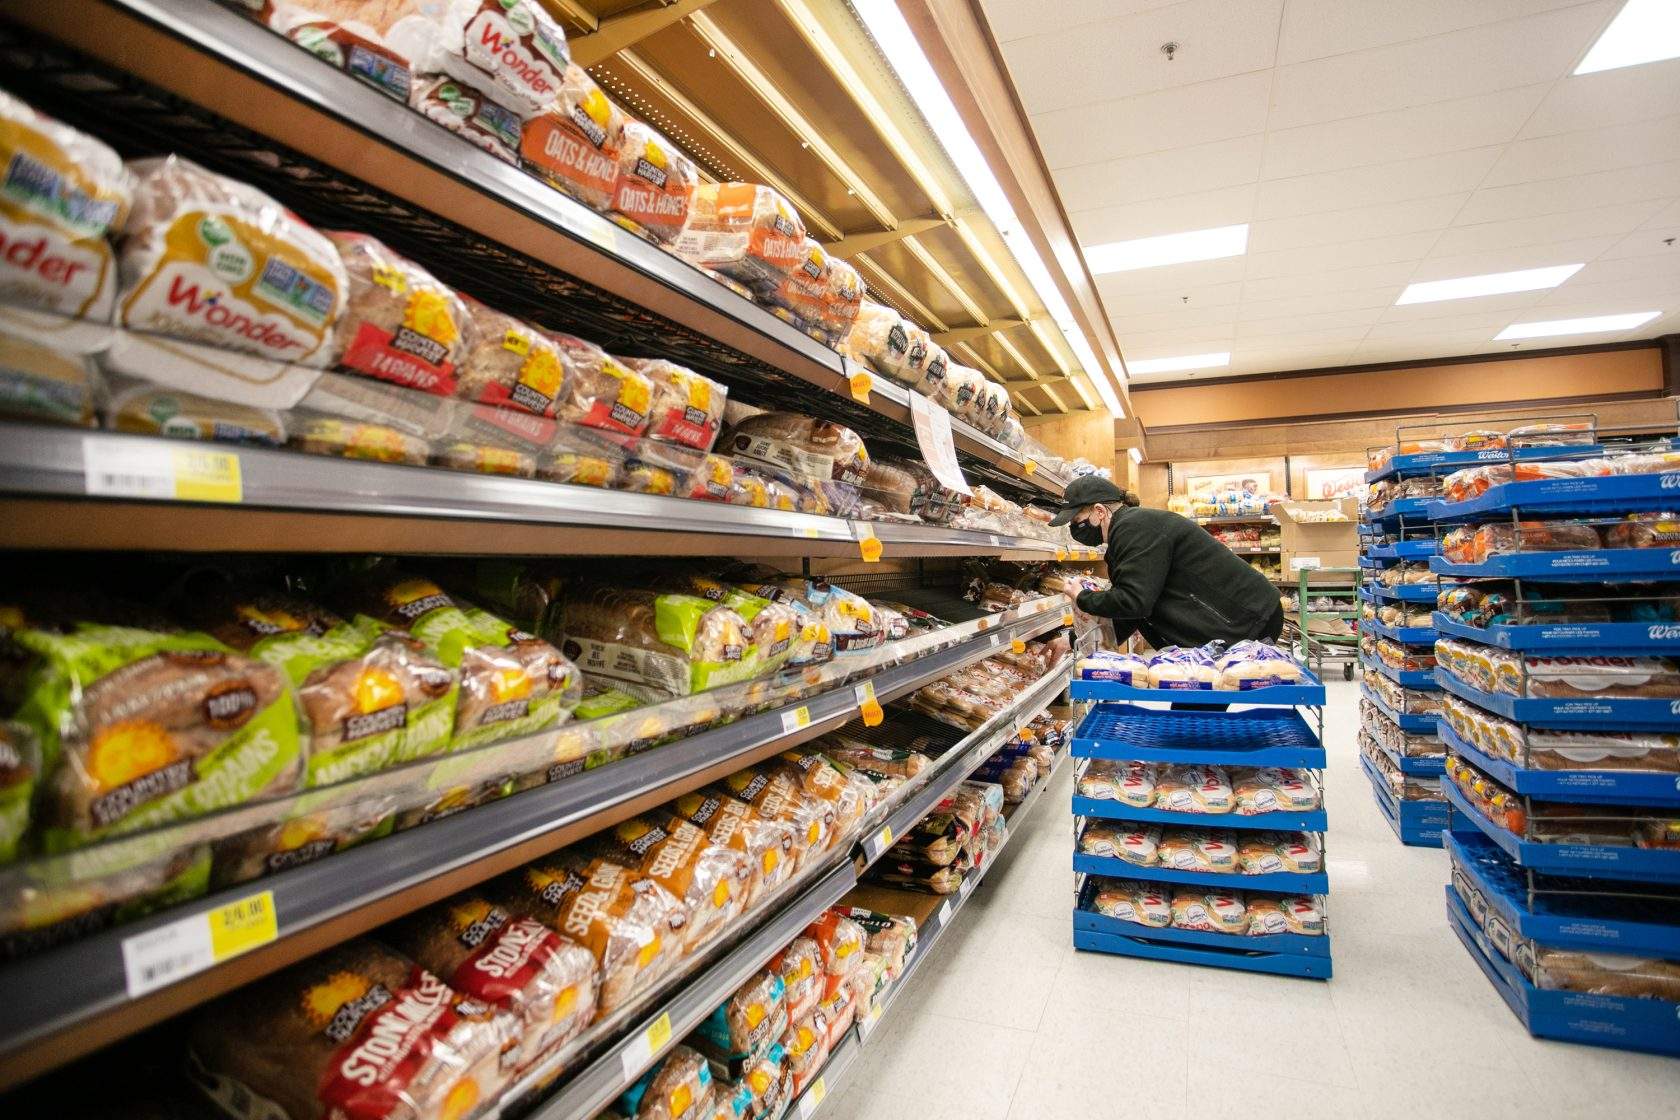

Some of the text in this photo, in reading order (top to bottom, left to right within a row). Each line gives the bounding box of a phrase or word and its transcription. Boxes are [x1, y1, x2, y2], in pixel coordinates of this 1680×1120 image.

[480, 22, 554, 95] Wonder
[544, 129, 578, 168] OATS
[575, 147, 589, 171] &
[620, 187, 647, 213] OATS
[657, 193, 688, 217] HONEY
[168, 275, 302, 350] Wonder
